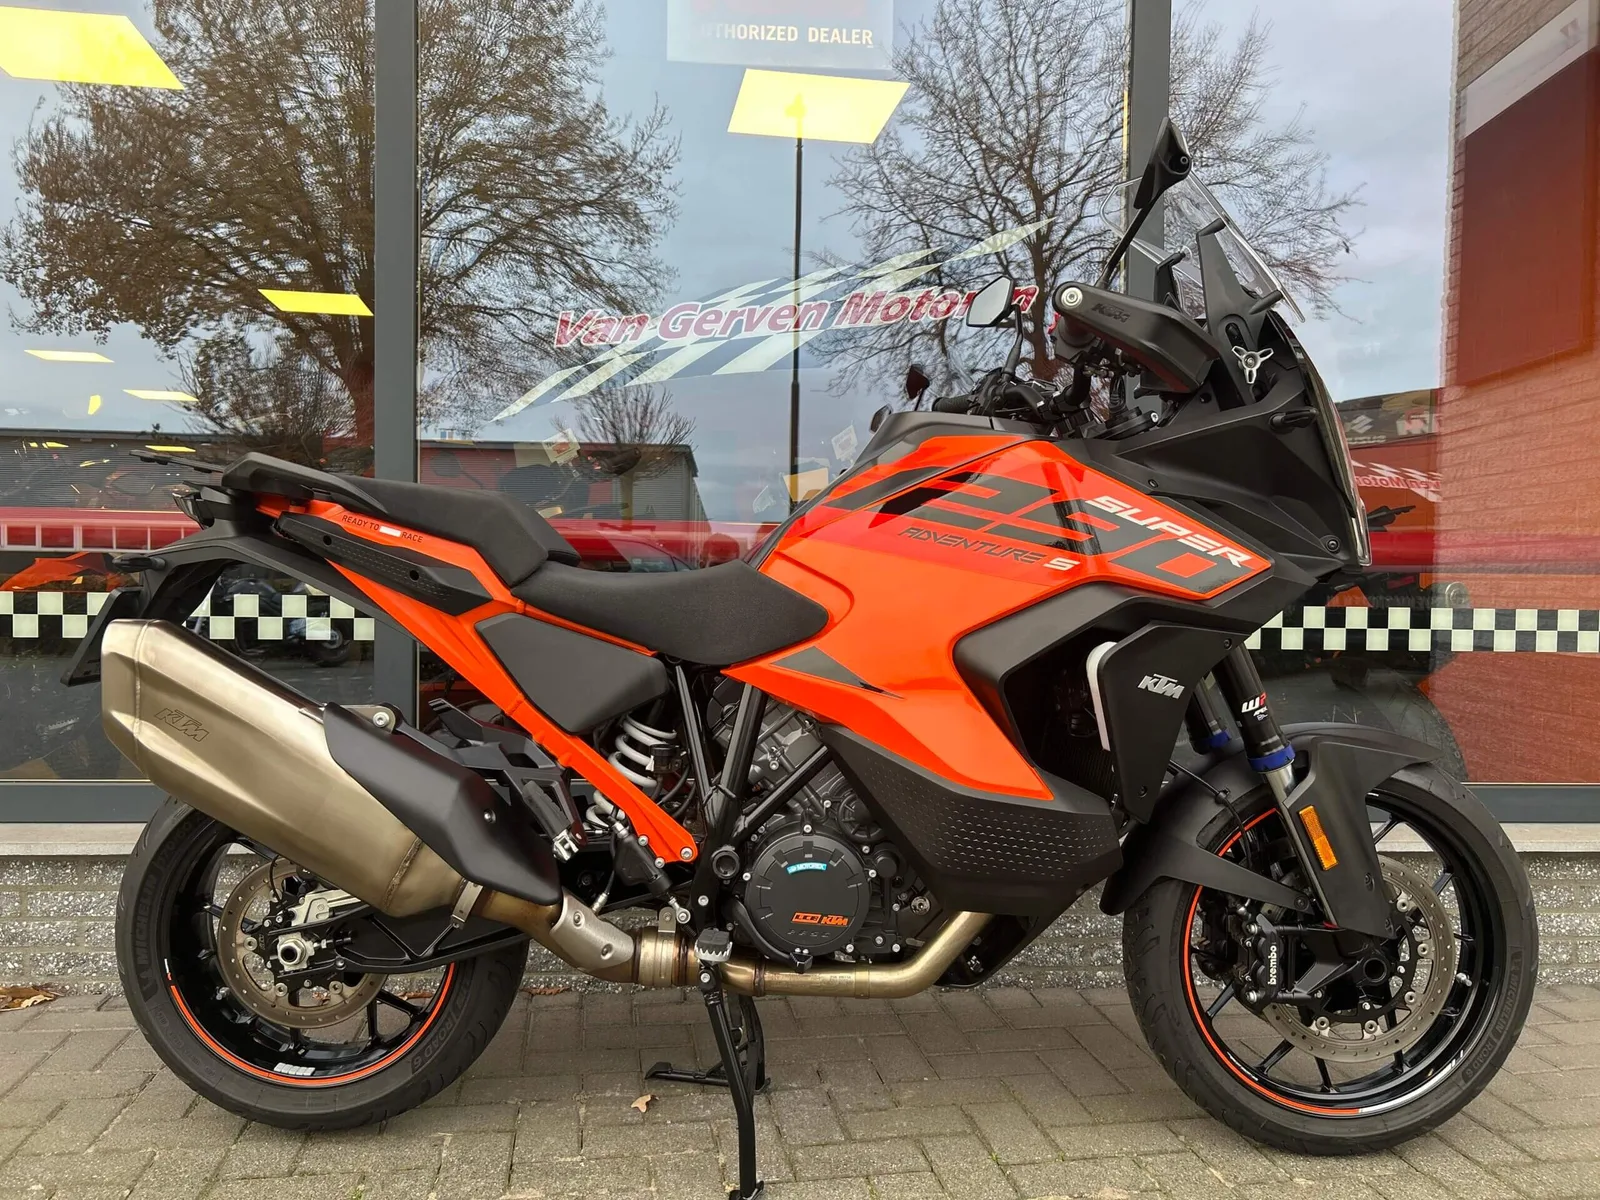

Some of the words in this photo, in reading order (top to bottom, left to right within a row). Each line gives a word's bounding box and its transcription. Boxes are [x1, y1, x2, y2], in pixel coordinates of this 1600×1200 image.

[807, 26, 874, 46] DEALER
[554, 309, 650, 348] Van
[657, 300, 831, 341] Gerven
[834, 285, 1040, 327] Motorn
[341, 514, 369, 528] READY
[369, 521, 381, 531] TO
[401, 530, 424, 544] RACE
[898, 526, 1047, 564] ADVENTURE
[1042, 556, 1081, 571] S
[1085, 494, 1253, 569] SUPER
[1137, 673, 1186, 700] KTM
[153, 707, 210, 742] KTM
[134, 872, 159, 967] MICHELIN
[820, 914, 849, 926] KTM
[1267, 944, 1278, 986] brembo
[1495, 976, 1520, 1034] MICHELIN
[424, 1011, 456, 1059] ROAD
[1473, 1040, 1494, 1069] ROAD
